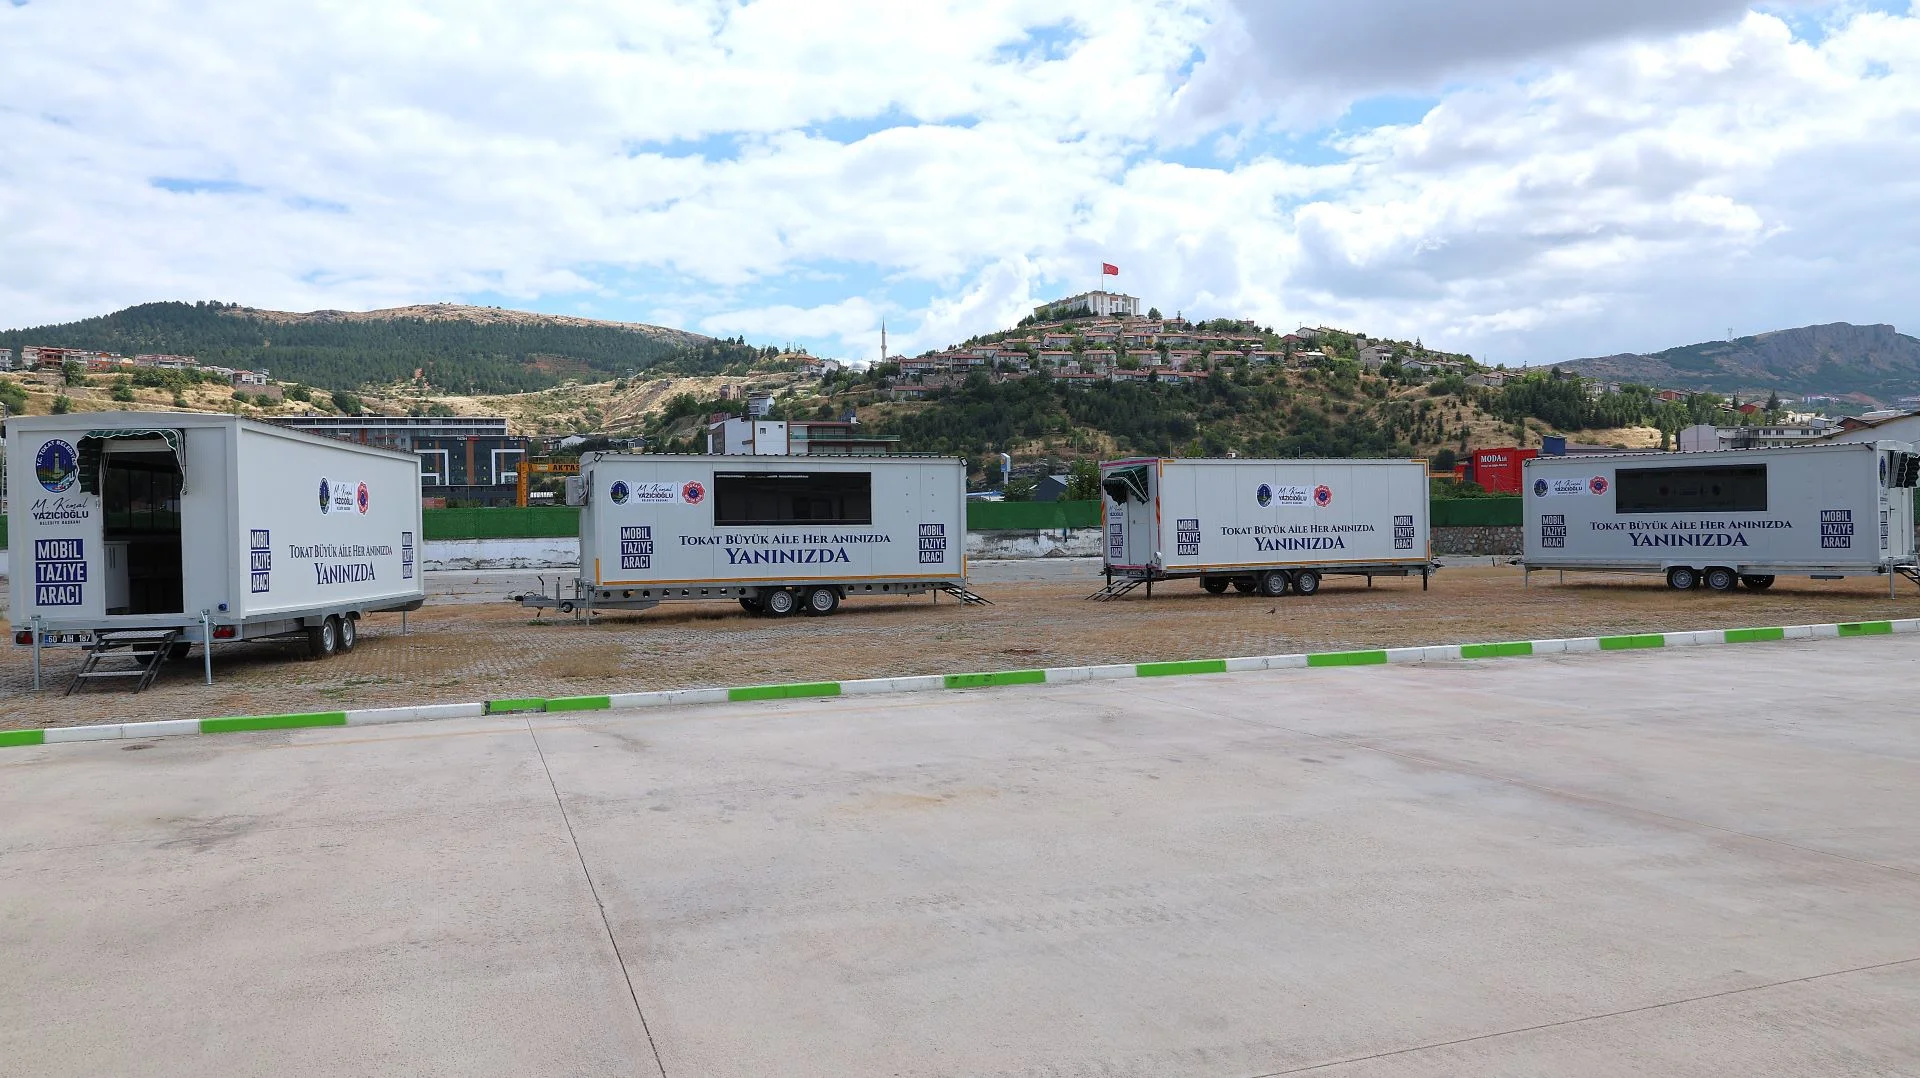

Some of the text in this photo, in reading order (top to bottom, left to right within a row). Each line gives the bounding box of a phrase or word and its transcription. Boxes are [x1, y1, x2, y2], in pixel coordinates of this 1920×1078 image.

[53, 497, 88, 511] Kemal
[33, 510, 89, 520] YAZICIOĞLU
[1221, 527, 1252, 536] TOKAT
[1254, 524, 1286, 535] BÜYÜK
[1310, 525, 1329, 533] HER
[1331, 525, 1375, 533] ANINIZDA
[1591, 522, 1626, 530] TOKAT
[1629, 520, 1669, 530] BÜYÜK
[1700, 521, 1725, 529] HER
[1728, 520, 1793, 529] ANINIZDA
[679, 535, 722, 546] TOKAT
[725, 533, 768, 545] BÜYÜK
[803, 534, 828, 544] HER
[830, 534, 891, 544] ANINIZDA
[1254, 536, 1345, 552] YANINIZDA
[1396, 539, 1412, 549] ARACI
[1543, 538, 1563, 547] ARACI
[1629, 532, 1749, 547] YANINIZDA
[1822, 537, 1850, 548] ARACI
[289, 544, 314, 559] TOKAT
[724, 547, 851, 565] YANINIZDA
[1178, 545, 1198, 555] ARACI
[623, 556, 650, 569] ARACI
[920, 551, 943, 562] ARACI
[314, 561, 376, 585] YANINIZDA
[38, 585, 80, 604] ARACI
[48, 635, 58, 643] 60
[79, 633, 91, 642] 187
